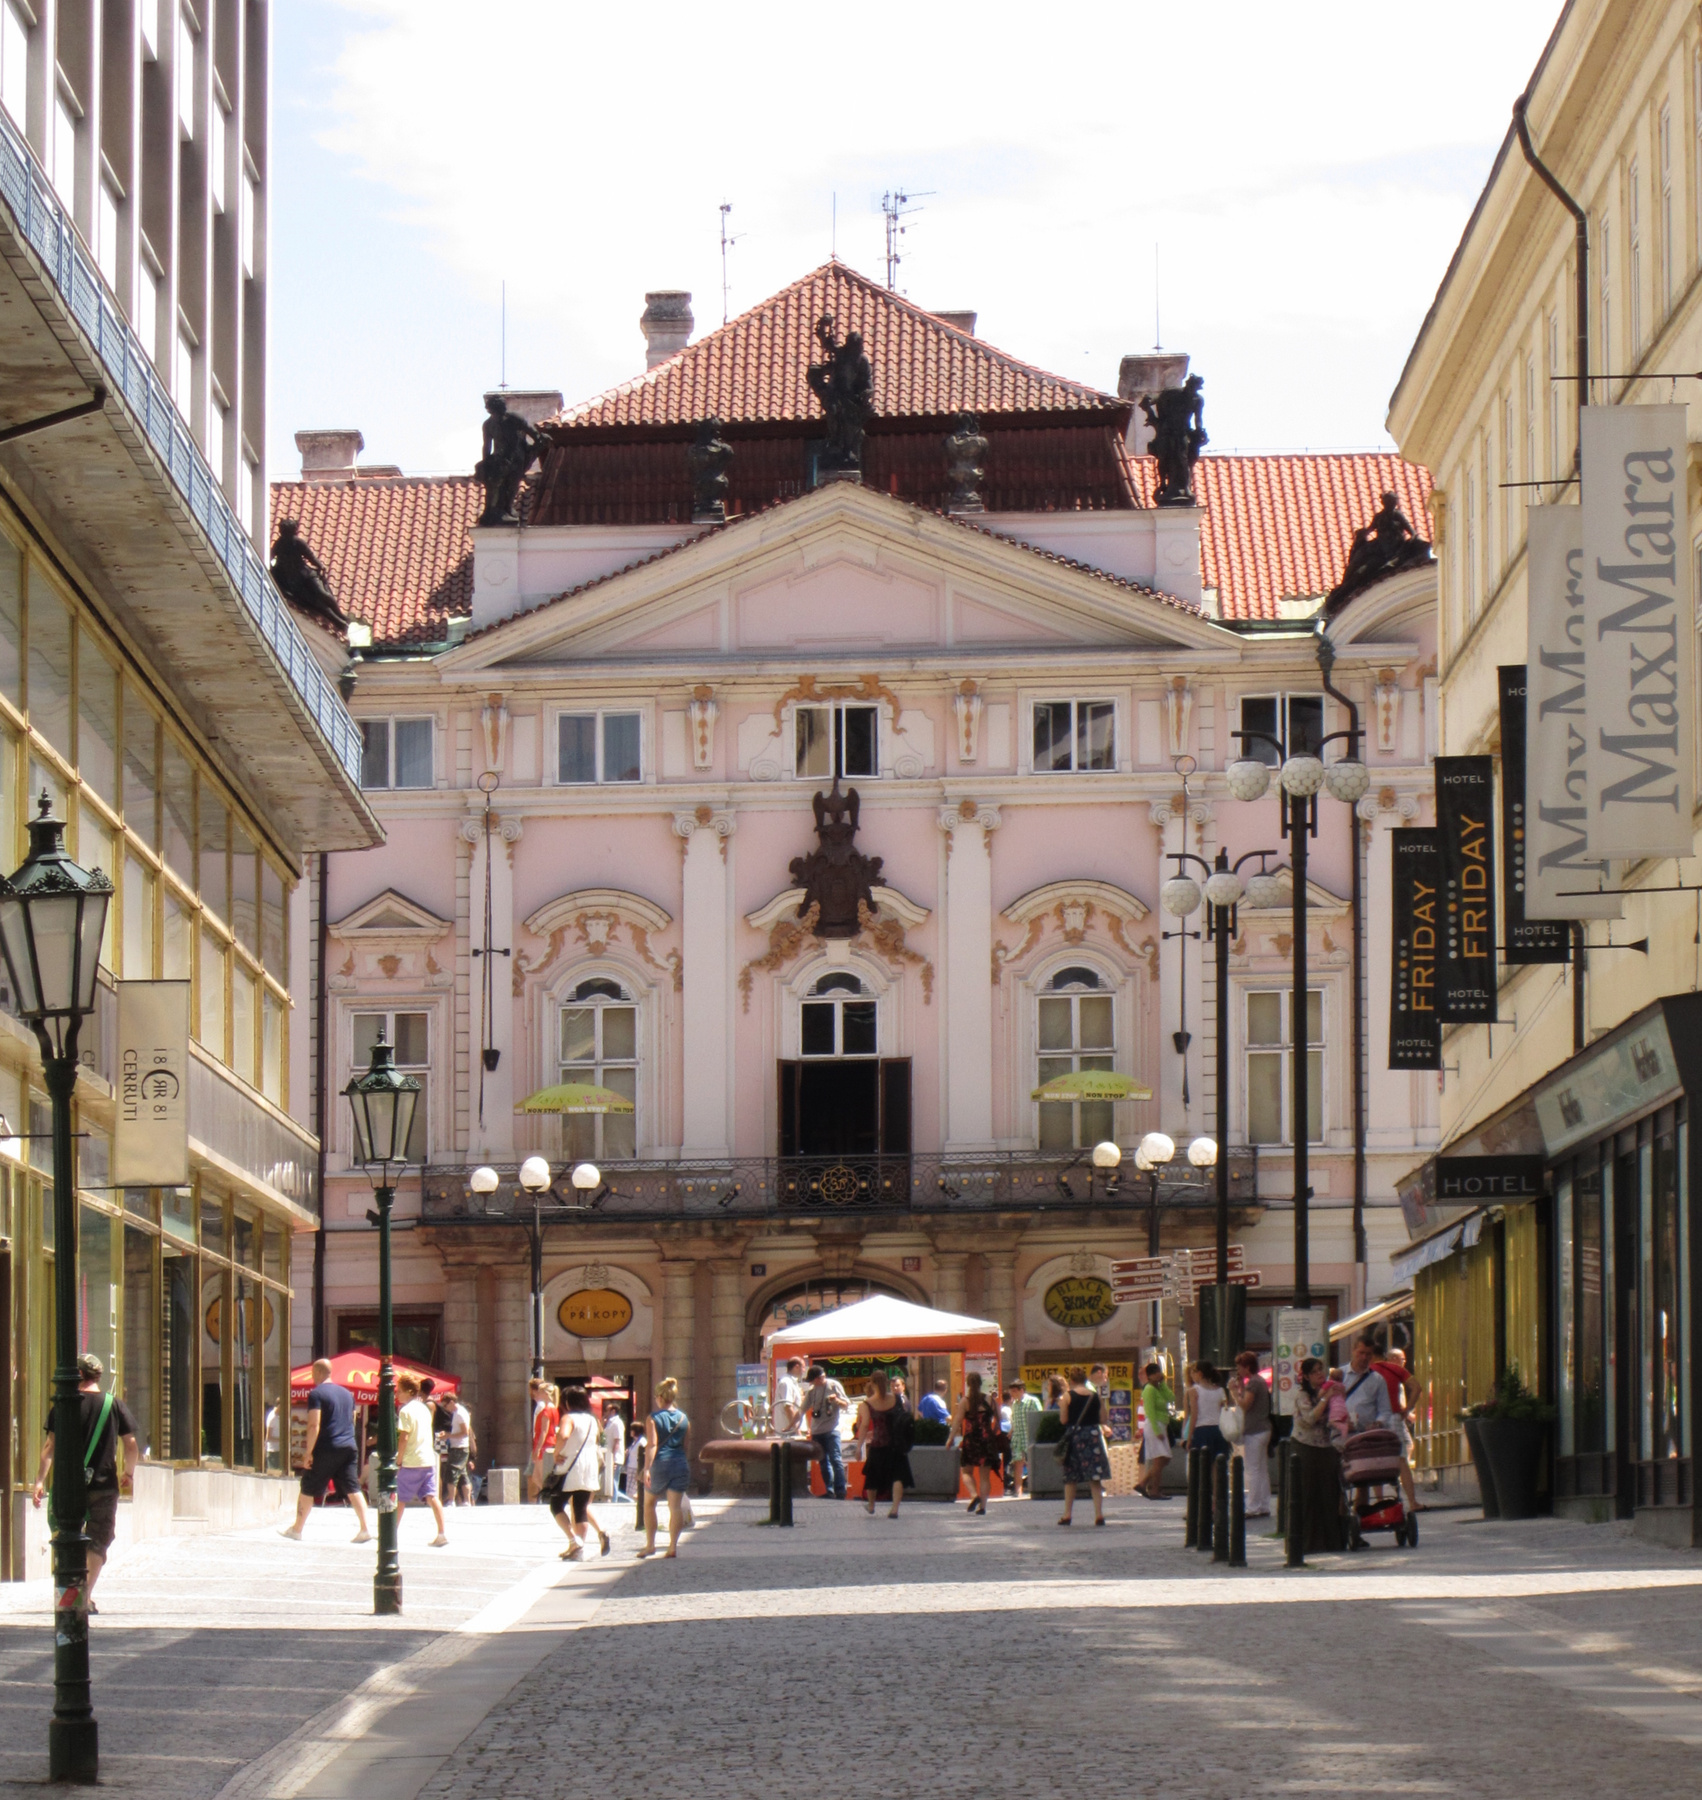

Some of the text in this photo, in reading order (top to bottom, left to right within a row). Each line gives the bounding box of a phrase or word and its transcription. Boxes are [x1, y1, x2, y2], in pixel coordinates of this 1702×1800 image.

[1596, 446, 1681, 814] MaxMara
[1443, 774, 1485, 784] HOTEL
[1399, 844, 1436, 854] HOTEL
[1460, 813, 1488, 960] FRIDAY
[1514, 925, 1560, 936] HOTEL
[1411, 879, 1436, 1012] FRIDAY
[1448, 989, 1489, 999] HOTEL
[1396, 1038, 1435, 1048] HOTEL
[123, 1049, 137, 1121] CERRUTI
[1443, 1175, 1537, 1194] HOTEL
[1056, 1281, 1104, 1297] BLACK
[1025, 1368, 1059, 1380] TICKET
